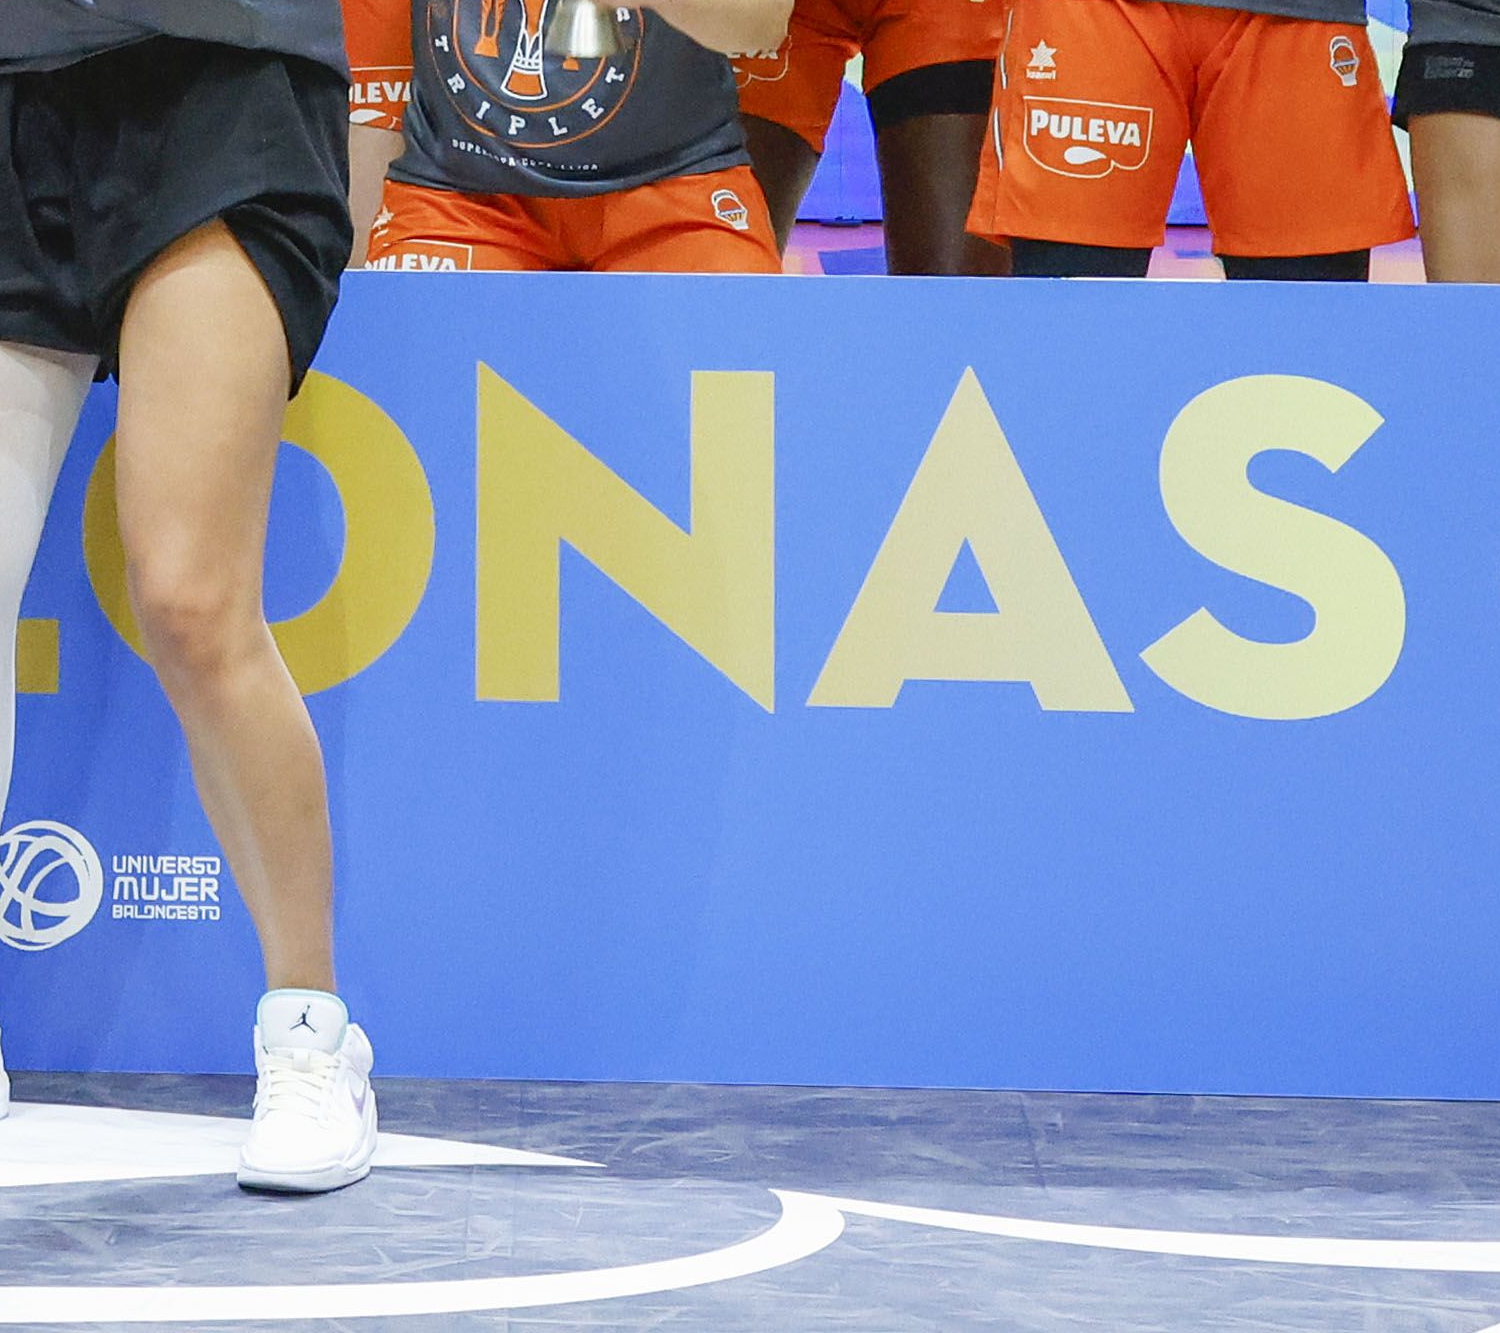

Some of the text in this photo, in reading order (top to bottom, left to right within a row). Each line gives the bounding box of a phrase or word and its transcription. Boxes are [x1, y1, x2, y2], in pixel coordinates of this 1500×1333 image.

[434, 36, 625, 137] TRIPLET
[1031, 109, 1143, 145] PULEVA
[112, 855, 221, 874] UNIVERSO
[112, 876, 220, 902] MUJER
